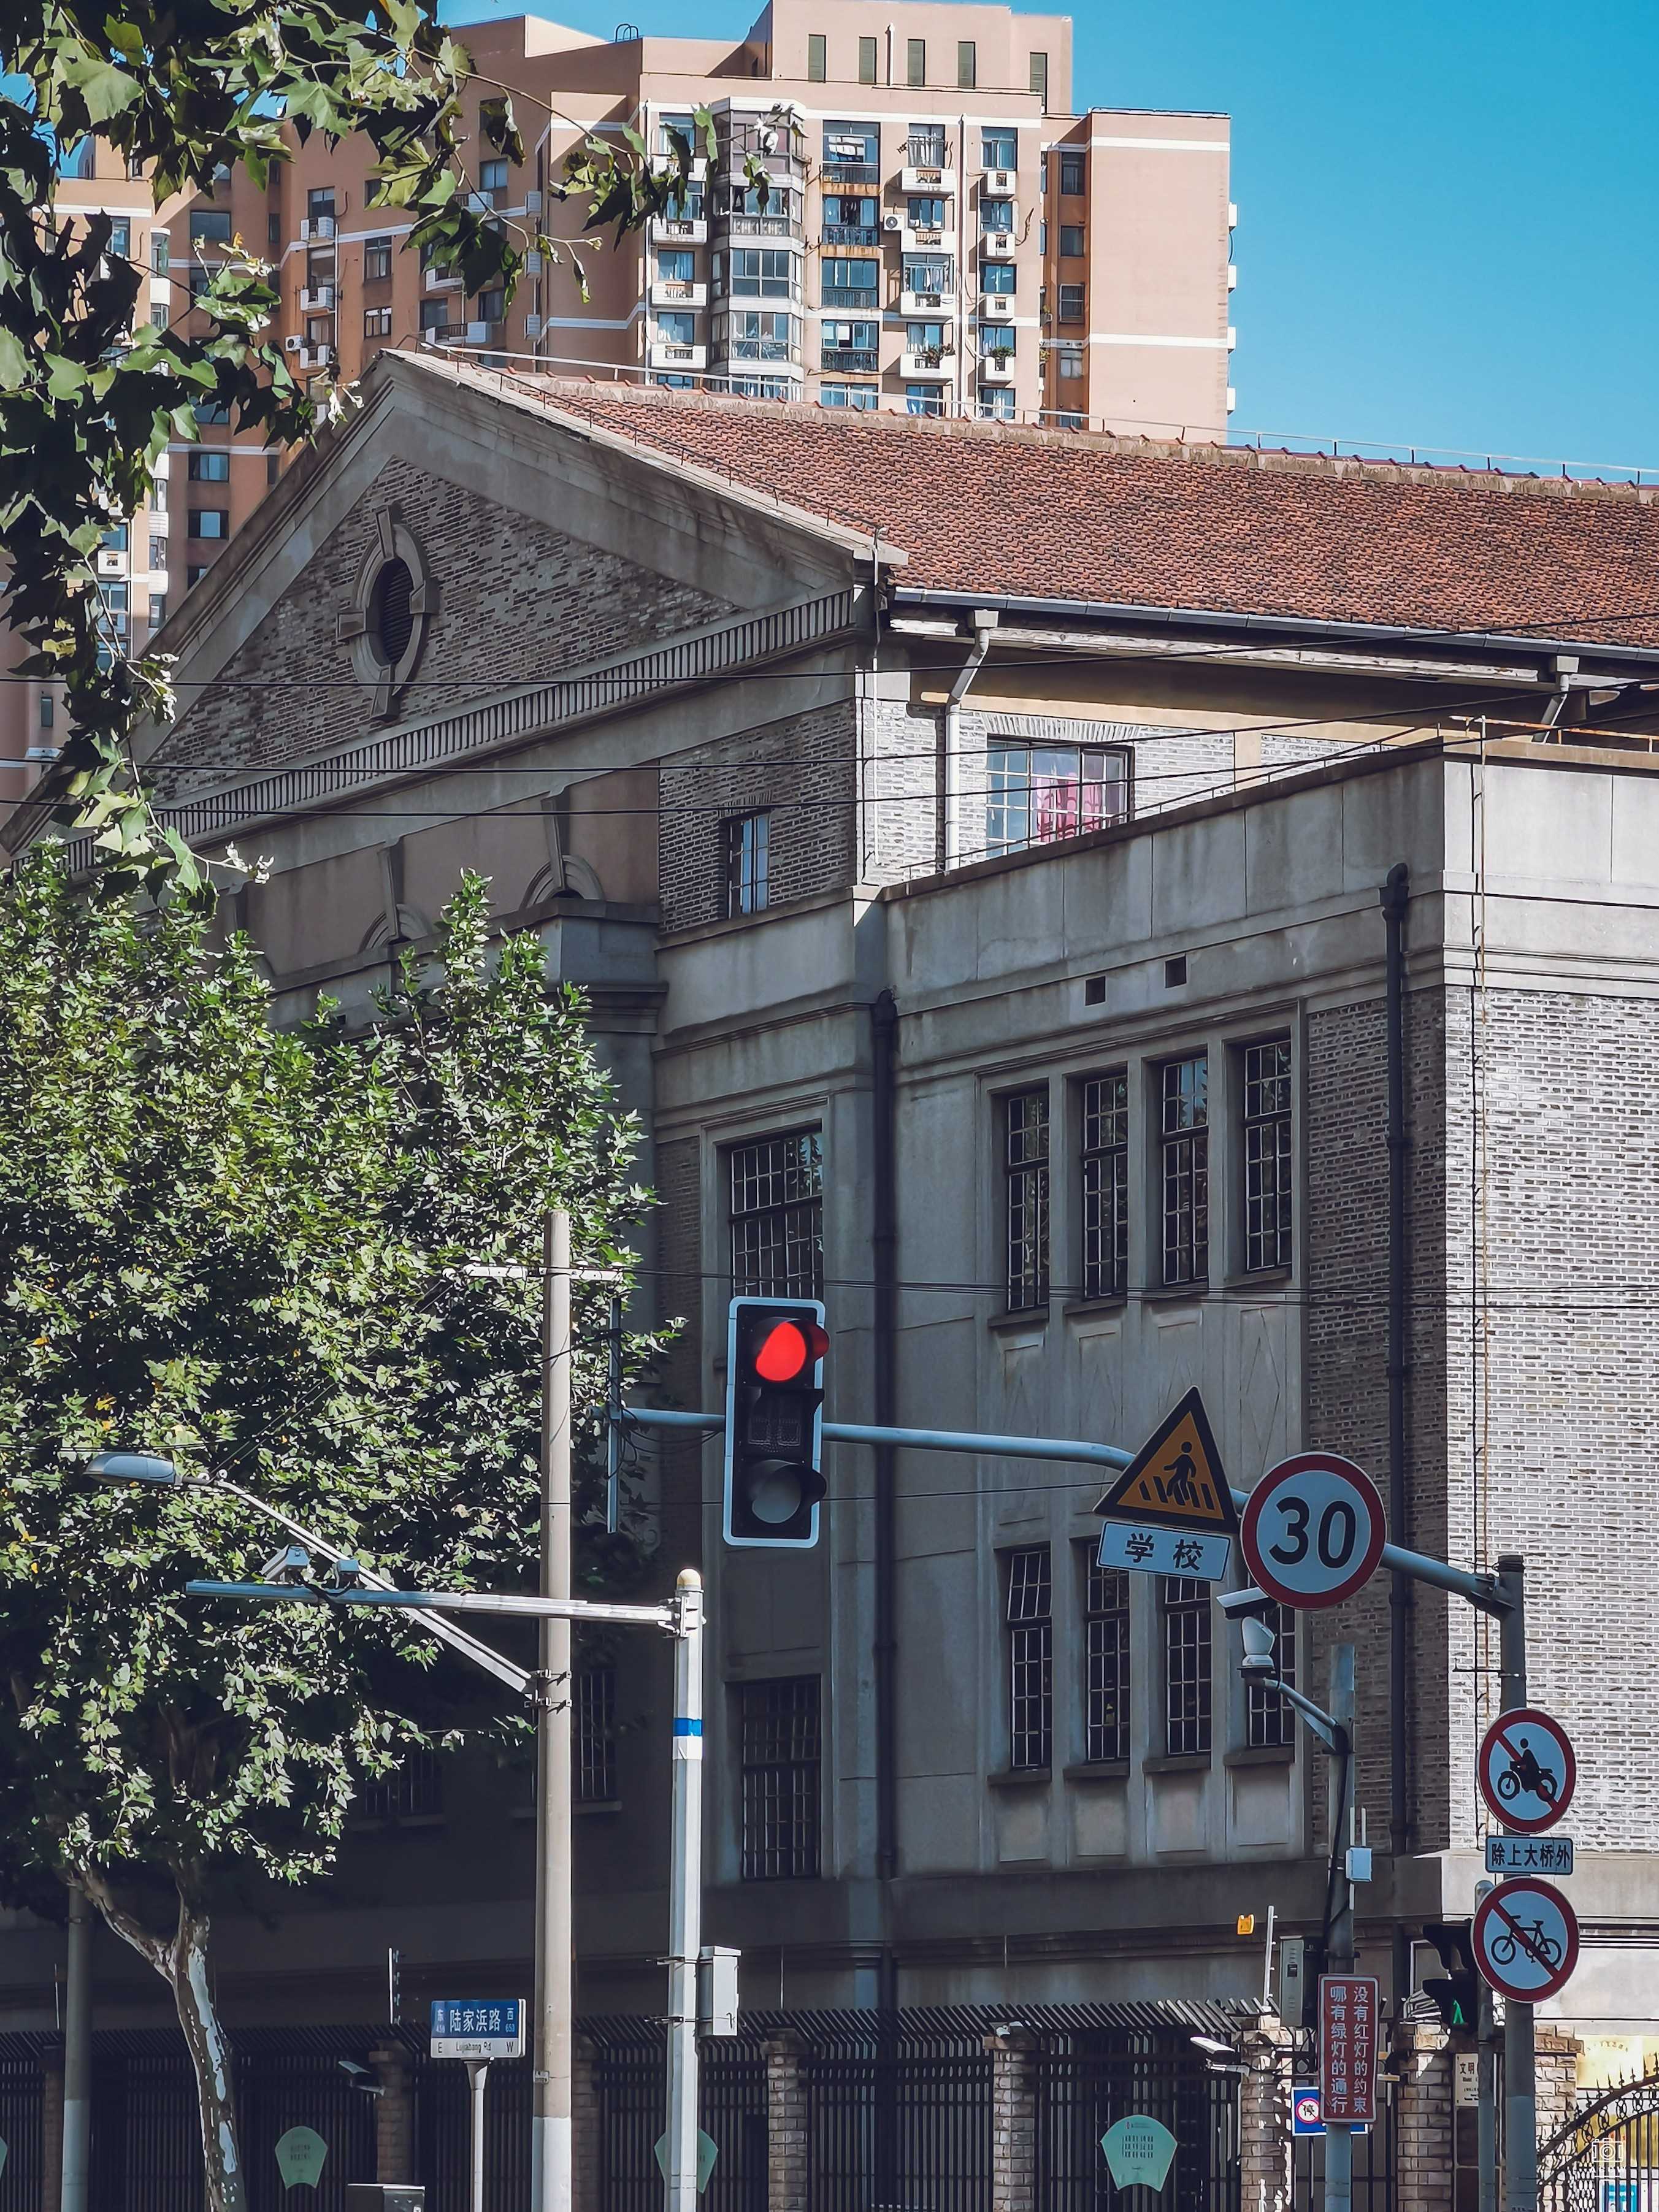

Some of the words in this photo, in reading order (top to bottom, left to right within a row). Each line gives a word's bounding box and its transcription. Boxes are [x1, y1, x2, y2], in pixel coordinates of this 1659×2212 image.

[1269, 1496, 1357, 1569] 30
[1125, 1533, 1203, 1571] 学校
[1491, 1842, 1570, 1868] 除上大桥外
[450, 2008, 501, 2033] 陆家浜路
[438, 2042, 442, 2053] E
[506, 2042, 514, 2053] W
[1330, 1986, 1347, 2113] 哪有绿灯的通行
[1354, 1986, 1370, 2113] 没有红灯的约束
